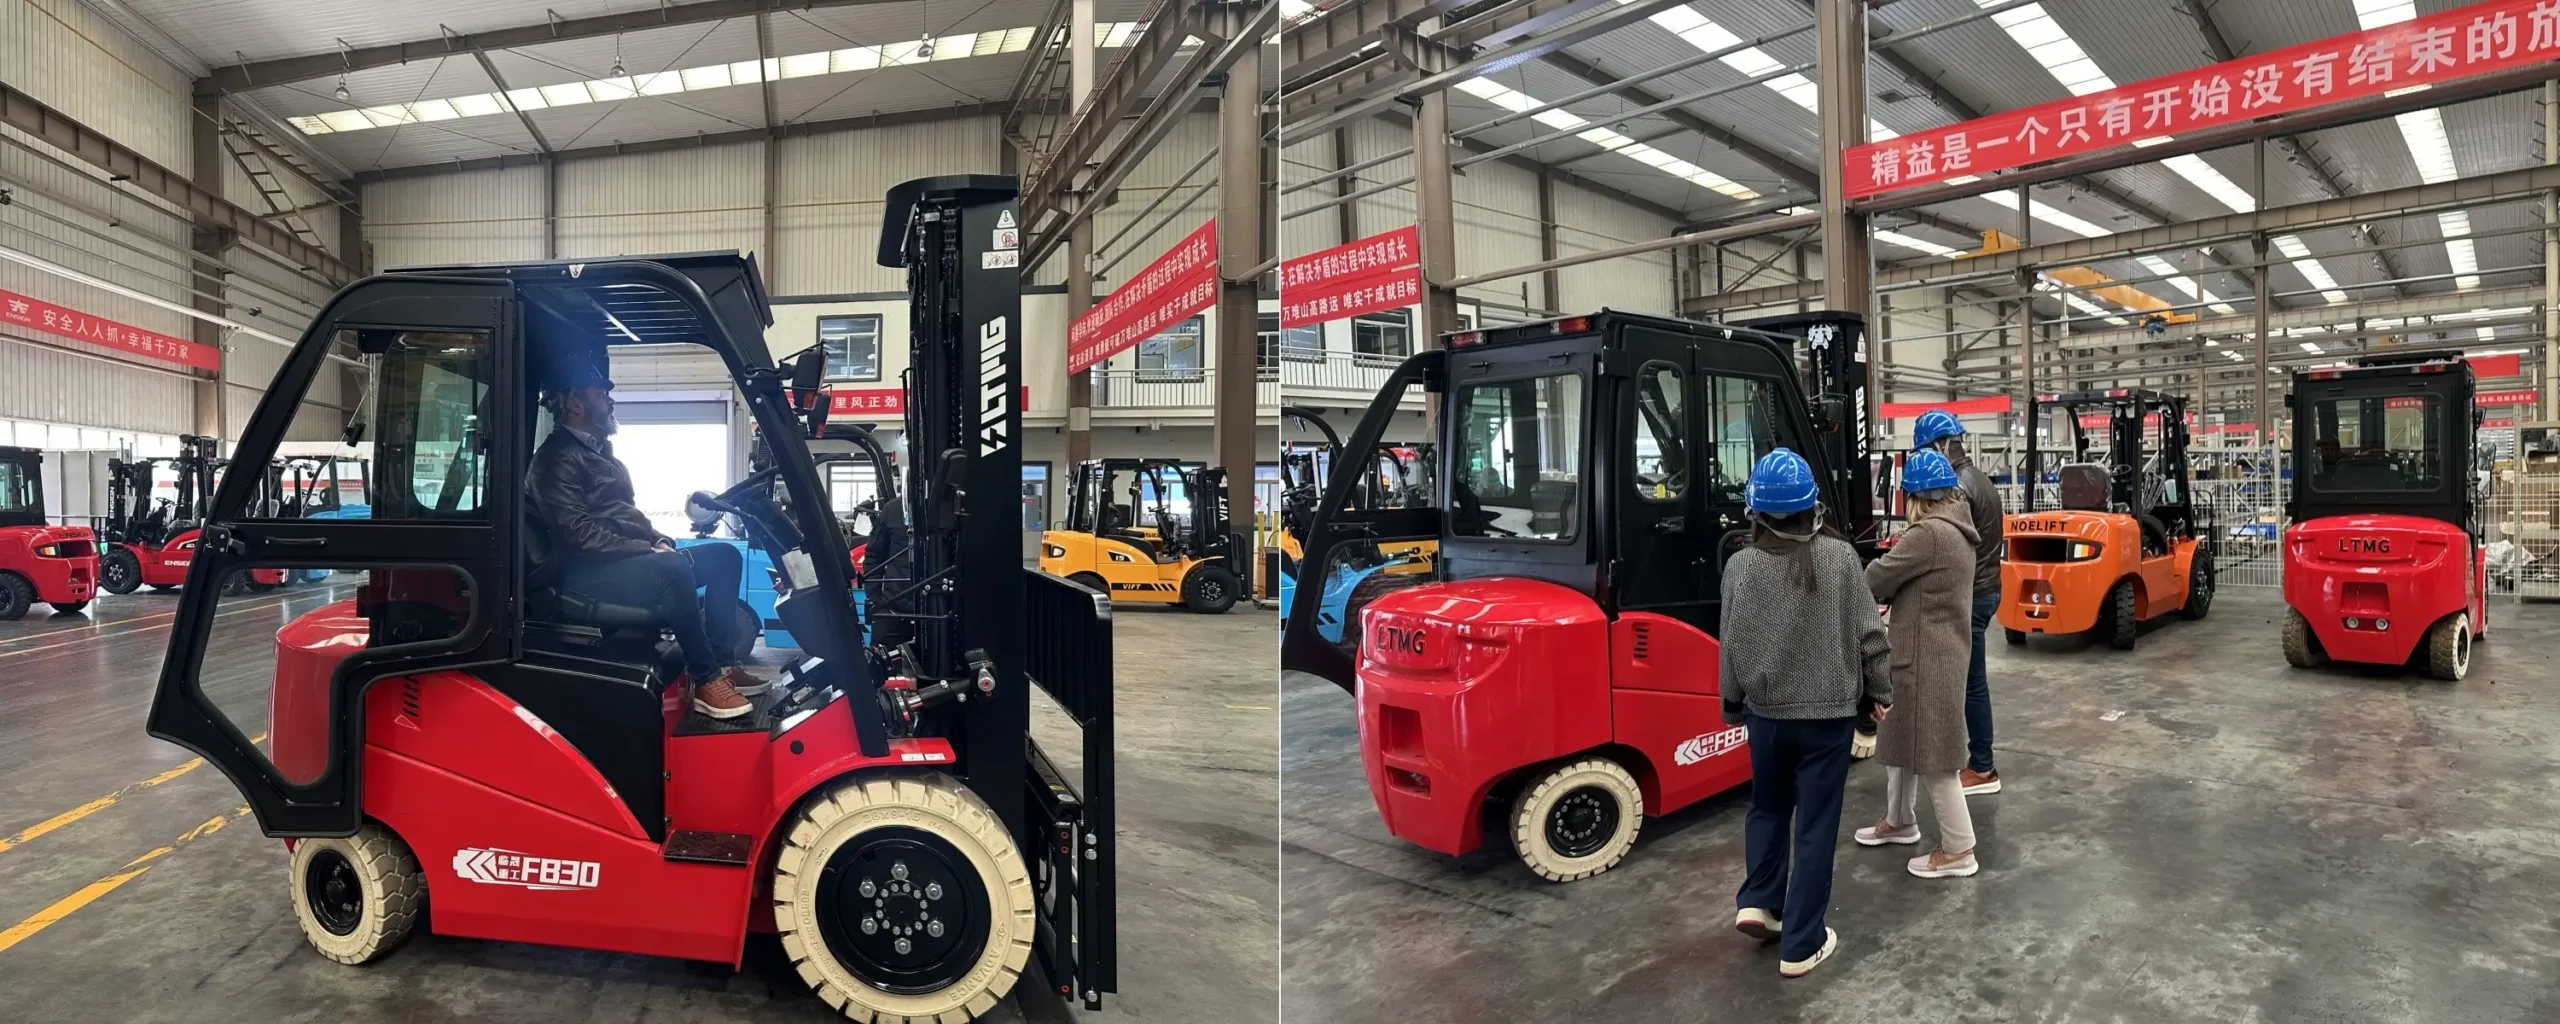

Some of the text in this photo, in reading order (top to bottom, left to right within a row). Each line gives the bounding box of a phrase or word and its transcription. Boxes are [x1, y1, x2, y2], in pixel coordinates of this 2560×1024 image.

[1343, 278, 1416, 310] 唯实干成就目标
[1219, 496, 1229, 522] VIFT
[2010, 520, 2067, 532] NOELIFT
[2339, 538, 2390, 553] LTMG
[1376, 623, 1426, 654] LTMG
[1714, 724, 1749, 752] FB3
[498, 868, 521, 881] 重工
[948, 947, 1001, 1001] ADVANCE
